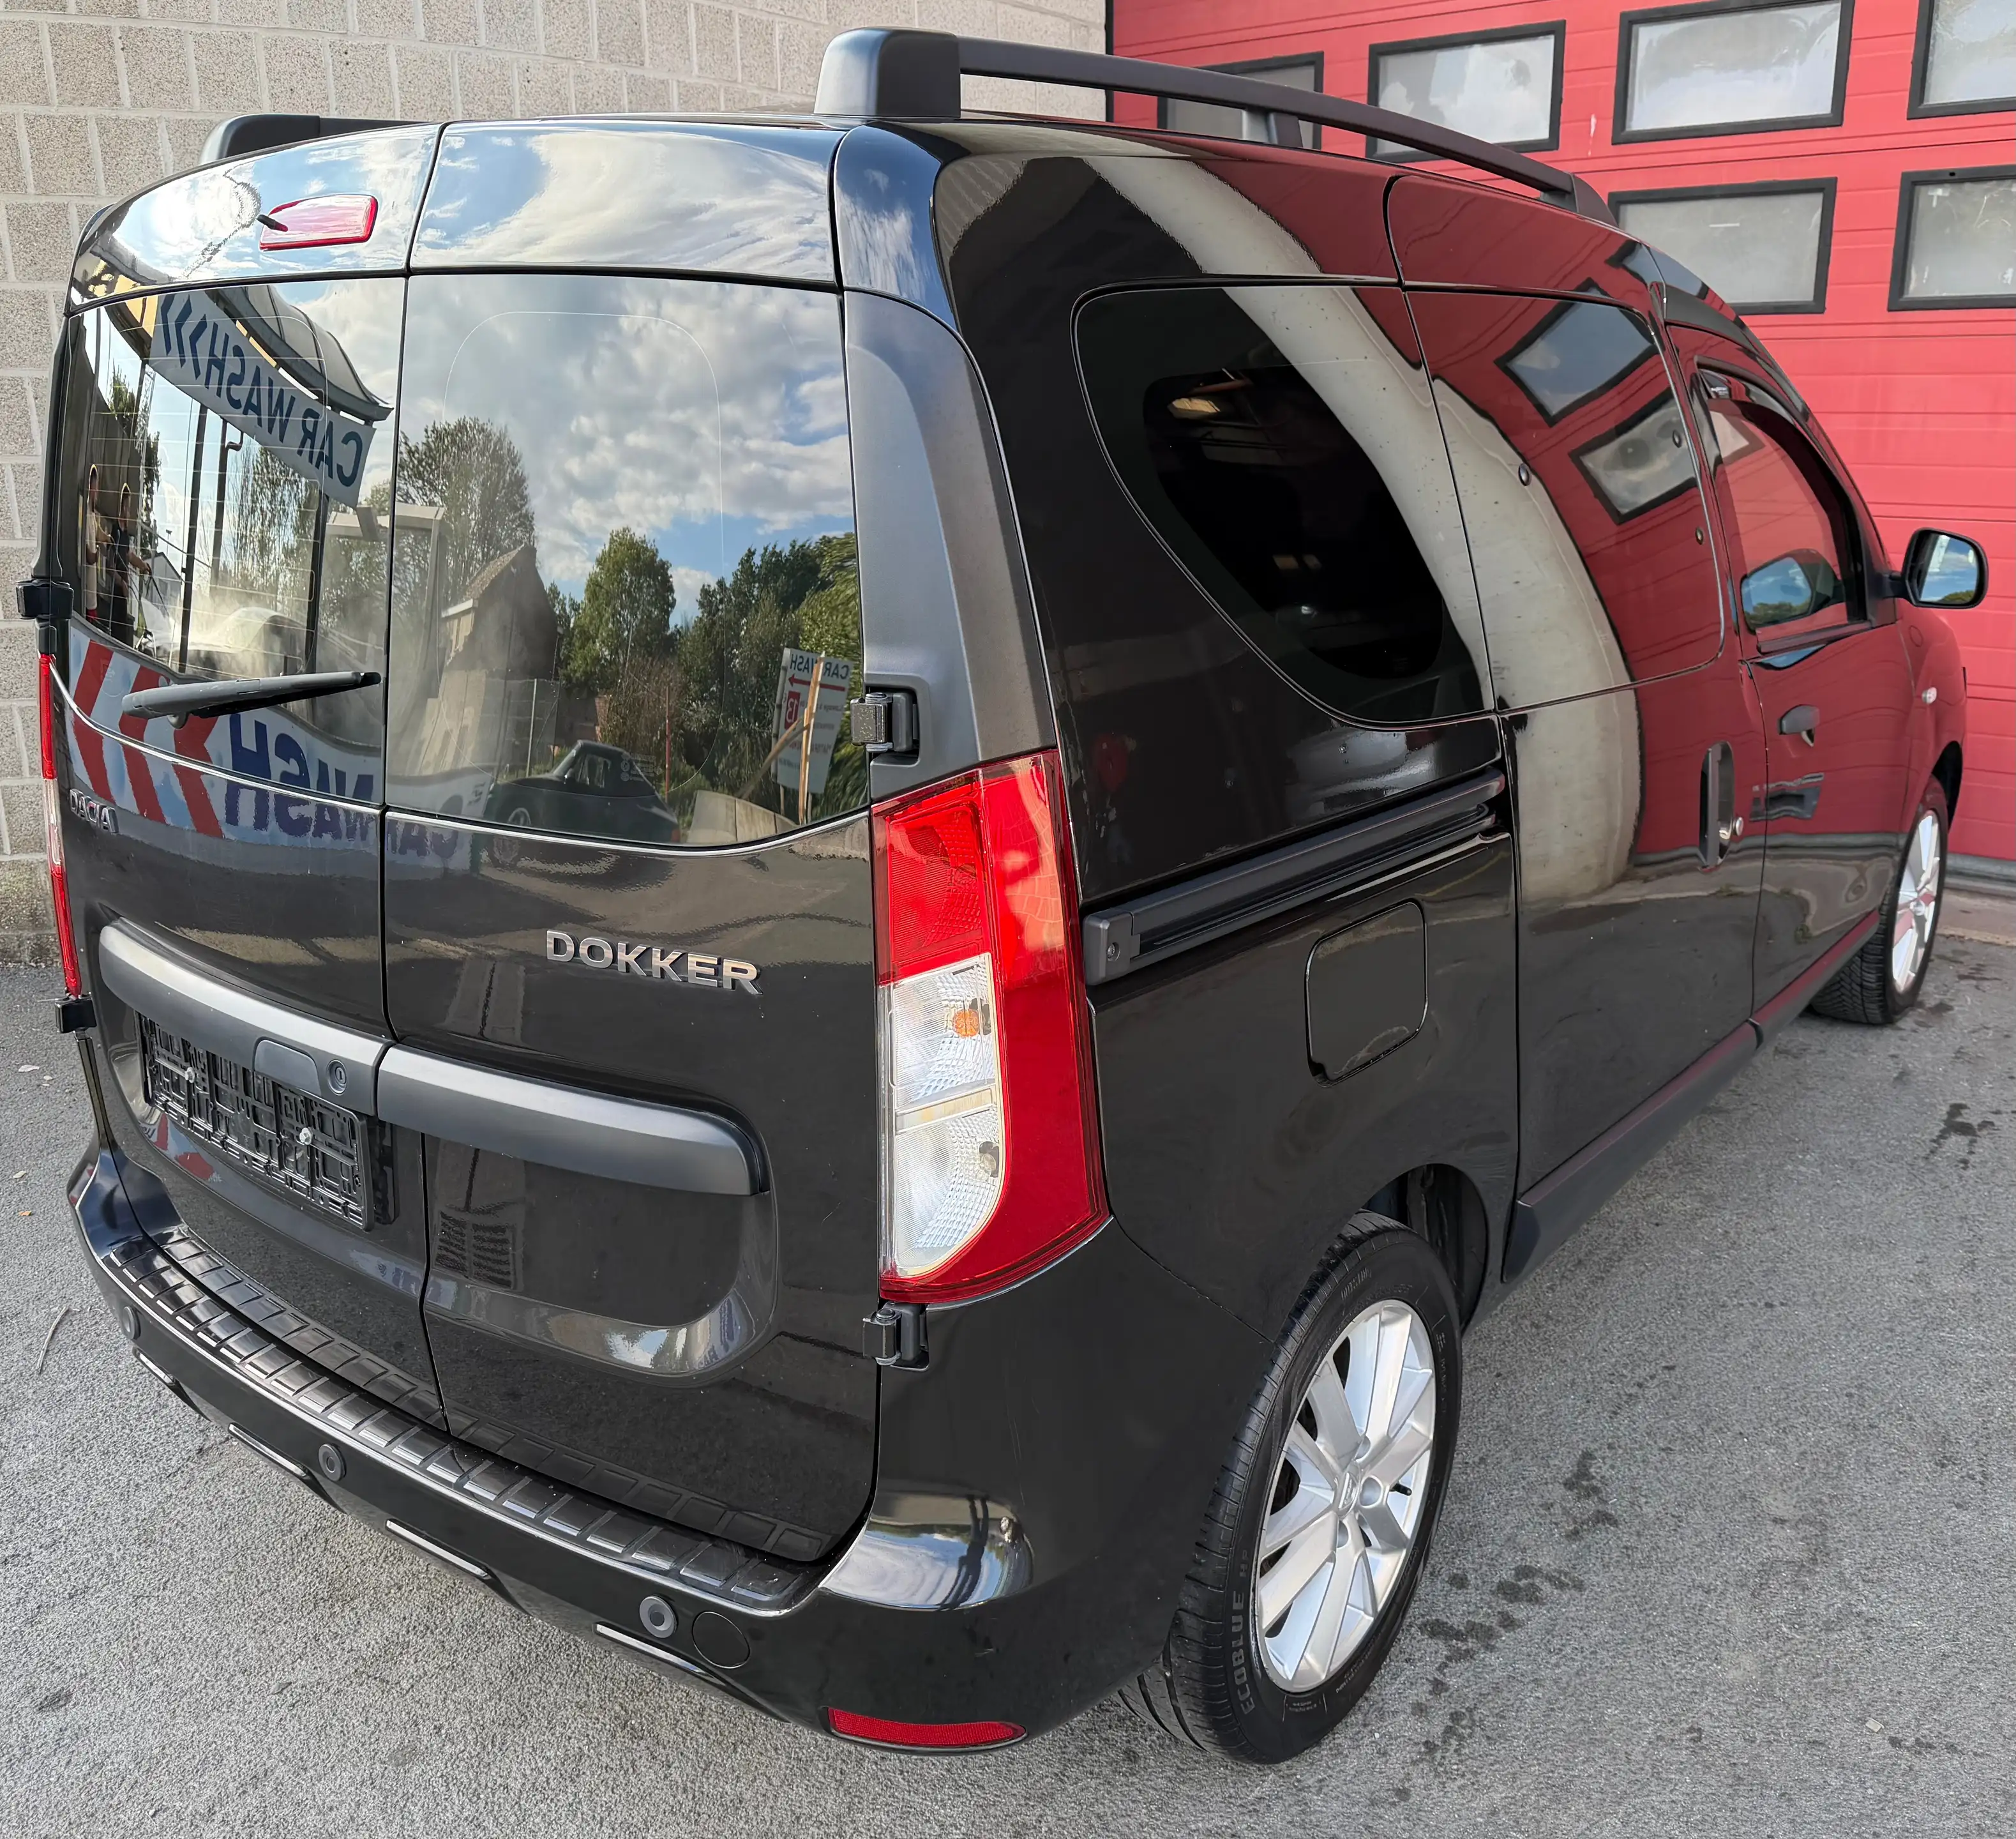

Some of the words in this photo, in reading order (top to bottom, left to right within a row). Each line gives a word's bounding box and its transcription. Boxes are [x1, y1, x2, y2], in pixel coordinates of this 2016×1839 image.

[69, 788, 119, 835] DACIA
[546, 929, 763, 995] DOKKER
[1231, 1591, 1256, 1715] ECOBLUE
